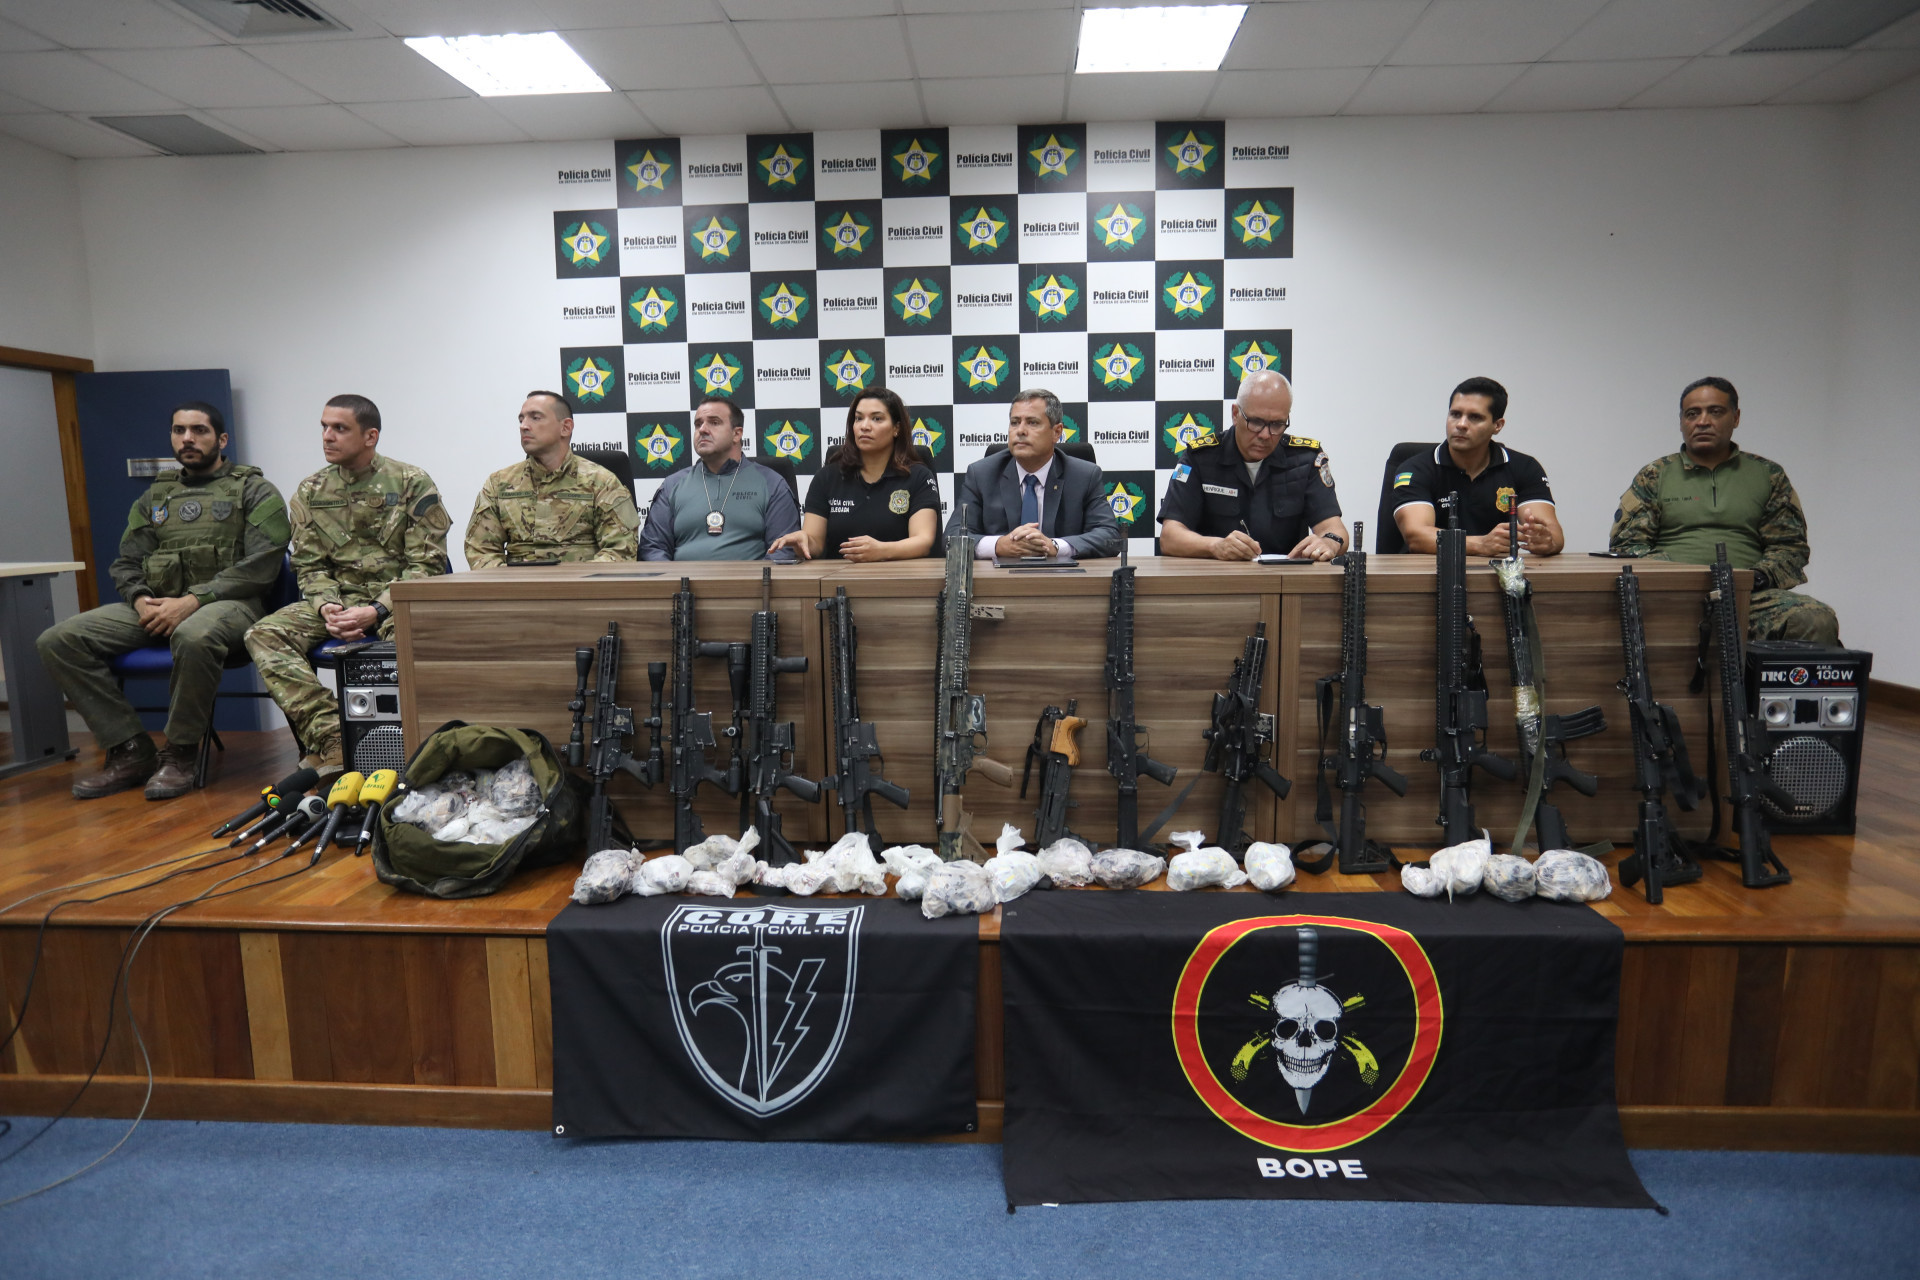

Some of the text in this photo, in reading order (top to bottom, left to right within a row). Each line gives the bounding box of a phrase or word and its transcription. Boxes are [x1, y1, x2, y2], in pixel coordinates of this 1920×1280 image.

[1094, 149, 1150, 160] Polícia Civil
[1233, 146, 1289, 156] Polícia Civil
[822, 158, 876, 169] Polícia Civil
[957, 153, 1012, 164] Polícia Civil
[689, 163, 742, 174] Polícia Civil
[558, 169, 611, 180] Polícia Civil
[1024, 222, 1079, 233] Polícia Civil
[1161, 219, 1217, 229] Polícia Civil
[755, 231, 808, 241] Polícia Civil
[888, 226, 943, 237] Polícia Civil
[624, 236, 676, 246] Polícia Civil
[958, 293, 1012, 303] Polícia Civil
[1094, 290, 1148, 300] Polícia Civil
[1230, 288, 1285, 298] Polícia Civil
[692, 301, 745, 311] Polícia Civil
[824, 297, 877, 307] Polícia Civil
[564, 306, 615, 316] Polícia Civil
[890, 364, 943, 374] Polícia Civil
[1024, 362, 1078, 371] Polícia Civil
[1160, 359, 1214, 369] Polícia Civil
[628, 372, 680, 381] Polícia Civil
[757, 368, 810, 378] Polícia Civil
[827, 435, 845, 445] Polí
[960, 433, 1008, 442] Polícia Civ
[1094, 431, 1149, 440] Polícia Civil
[571, 441, 622, 451] Polícia Civil
[684, 910, 850, 926] CORE
[678, 924, 750, 934] POLÍCIA
[1256, 1157, 1368, 1179] BOPE
